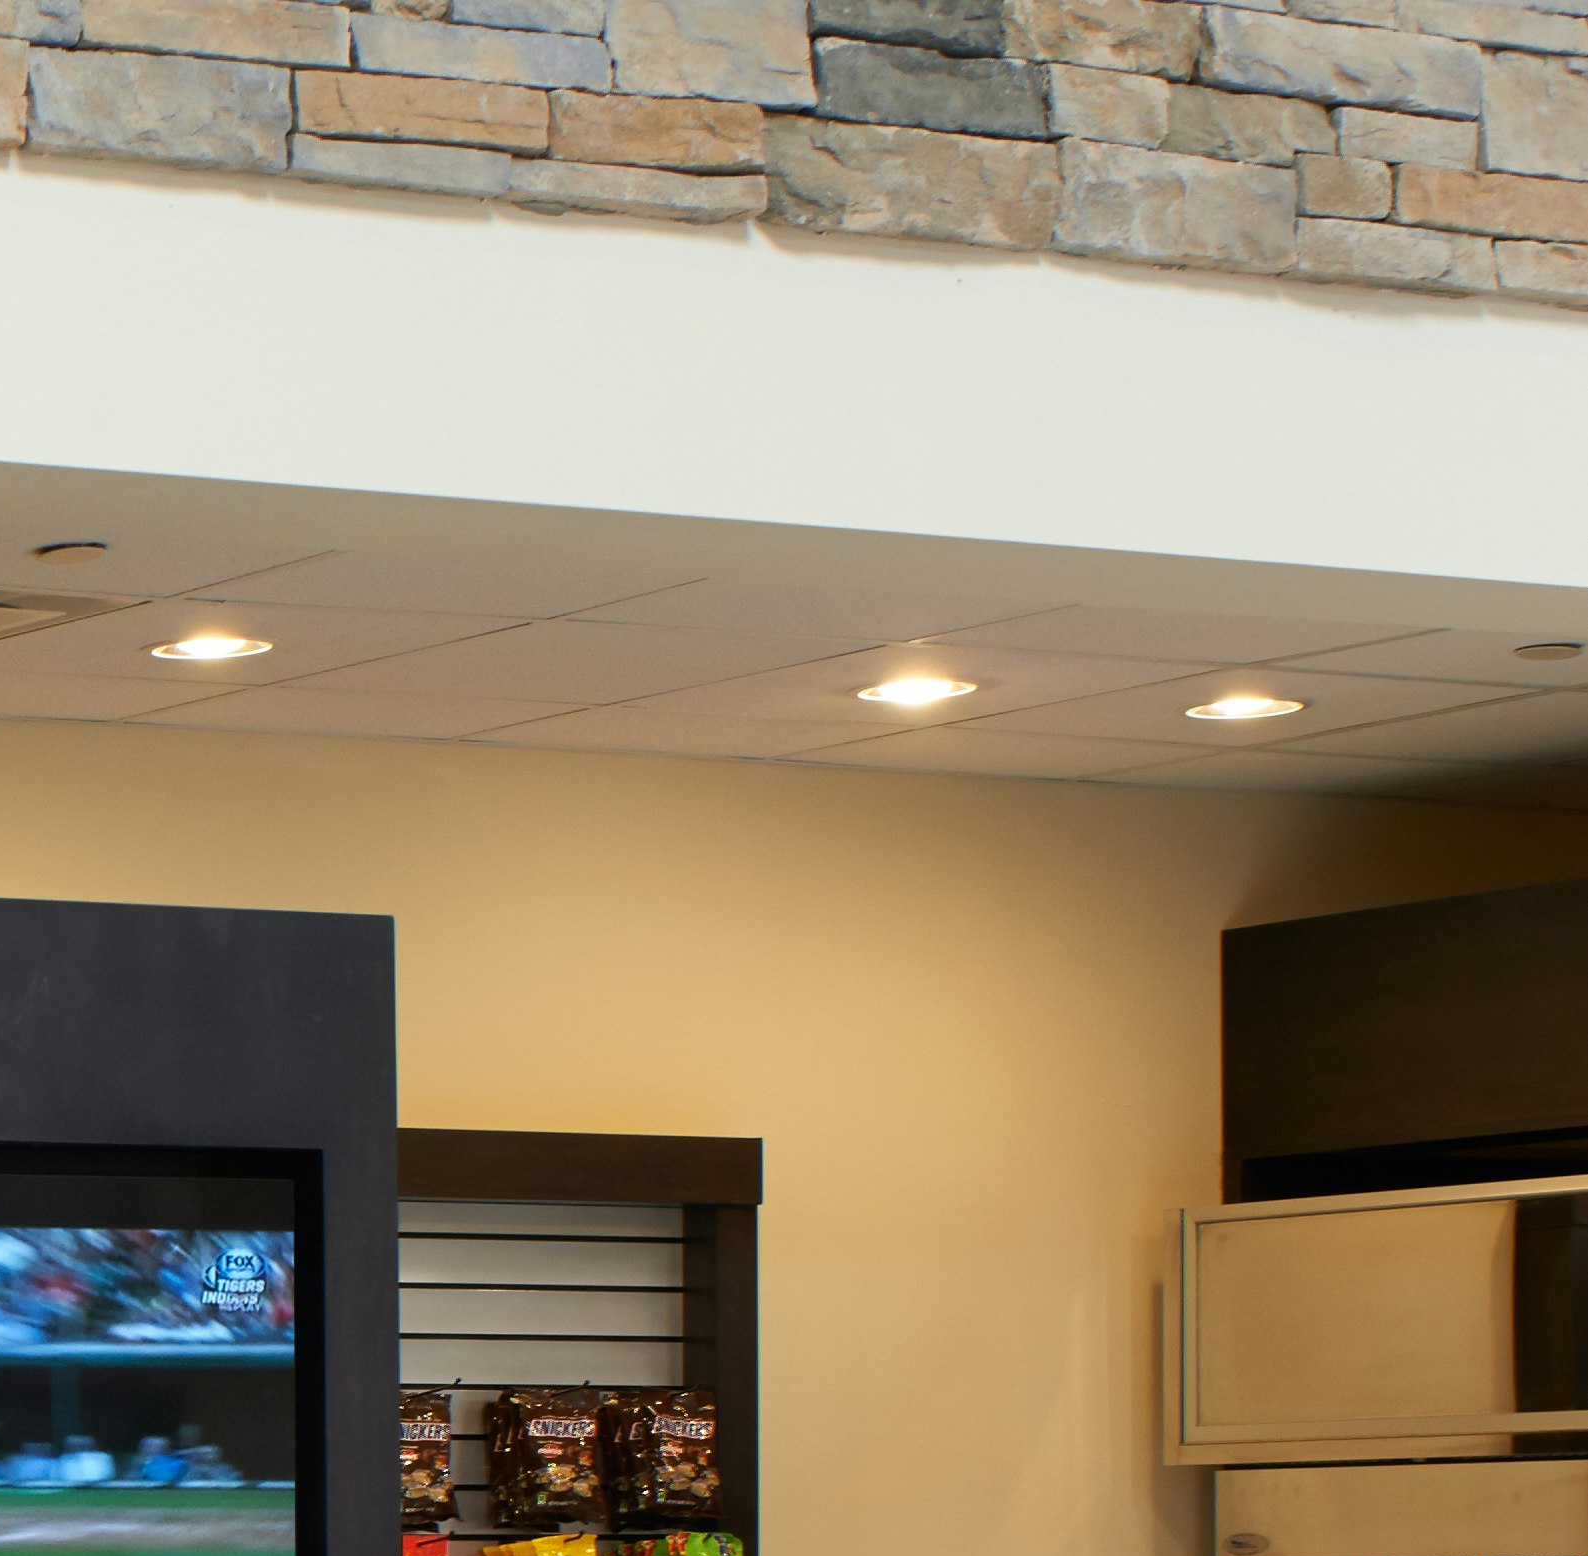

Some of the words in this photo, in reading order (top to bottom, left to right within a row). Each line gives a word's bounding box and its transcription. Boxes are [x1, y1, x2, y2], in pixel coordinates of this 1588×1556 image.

[226, 1256, 256, 1267] FOX
[217, 1280, 265, 1292] TIGERS
[528, 1419, 597, 1437] SNICKERS
[652, 1416, 715, 1439] SNICKERS
